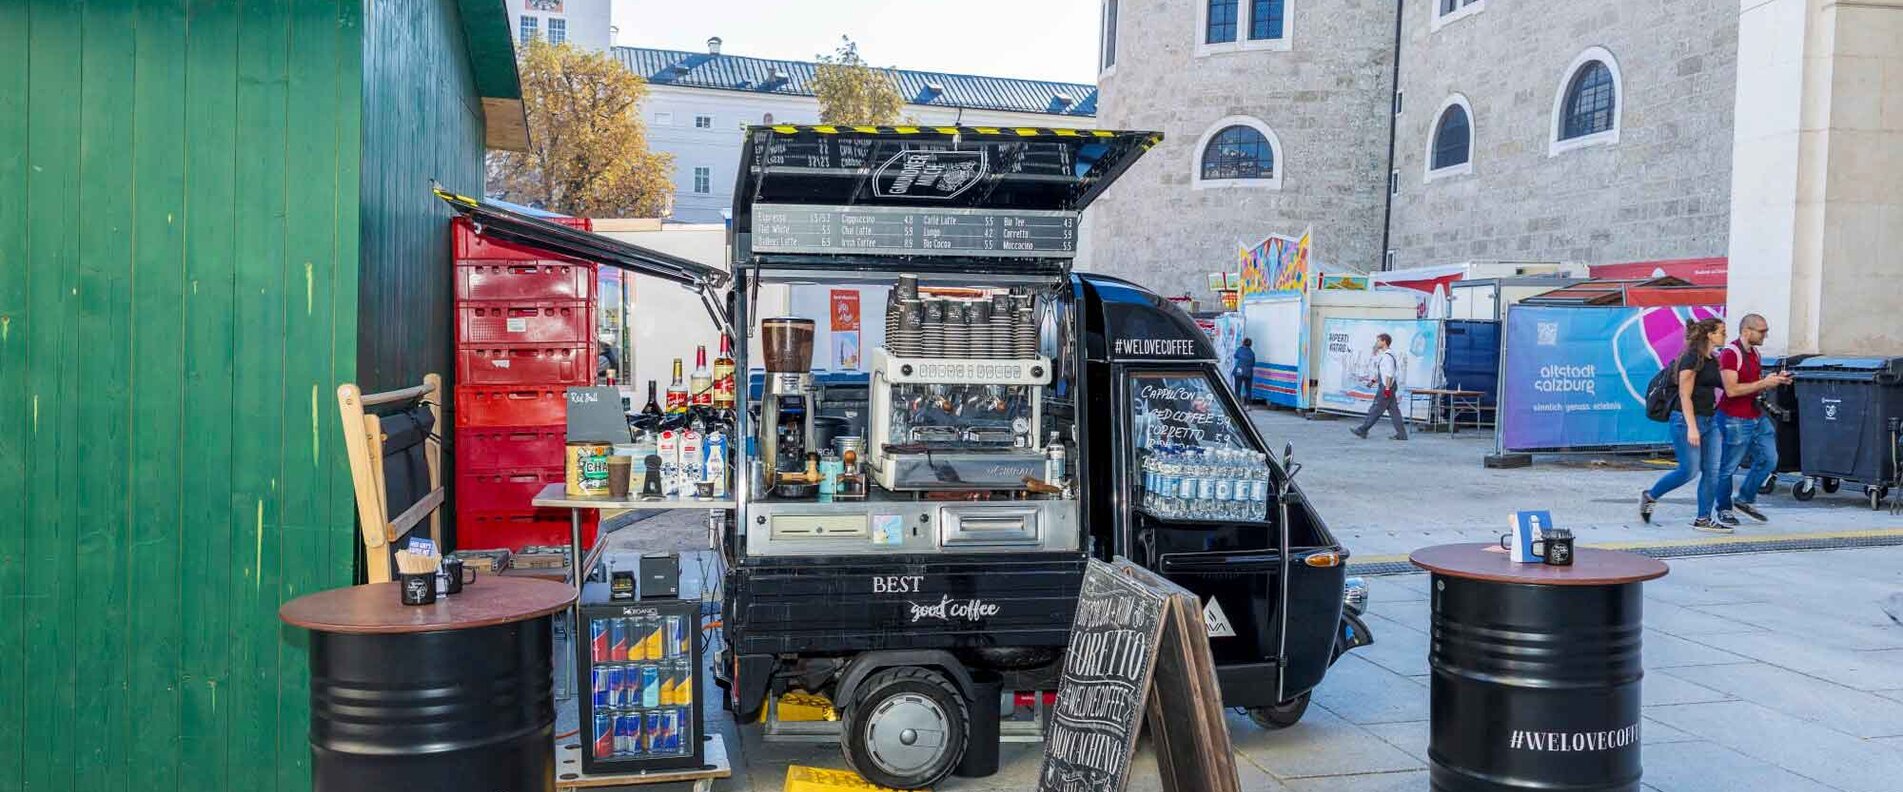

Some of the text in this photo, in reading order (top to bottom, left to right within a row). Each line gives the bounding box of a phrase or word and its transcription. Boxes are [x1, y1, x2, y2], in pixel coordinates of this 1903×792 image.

[855, 225, 872, 235] Latte
[1115, 339, 1195, 356] #WELOVECOFFEE
[1540, 364, 1597, 379] altstadt
[1535, 379, 1597, 396] salzburg
[873, 576, 925, 593] BEST
[908, 594, 1000, 622] good coffee
[1061, 685, 1128, 722] #WELOVECOFFEE
